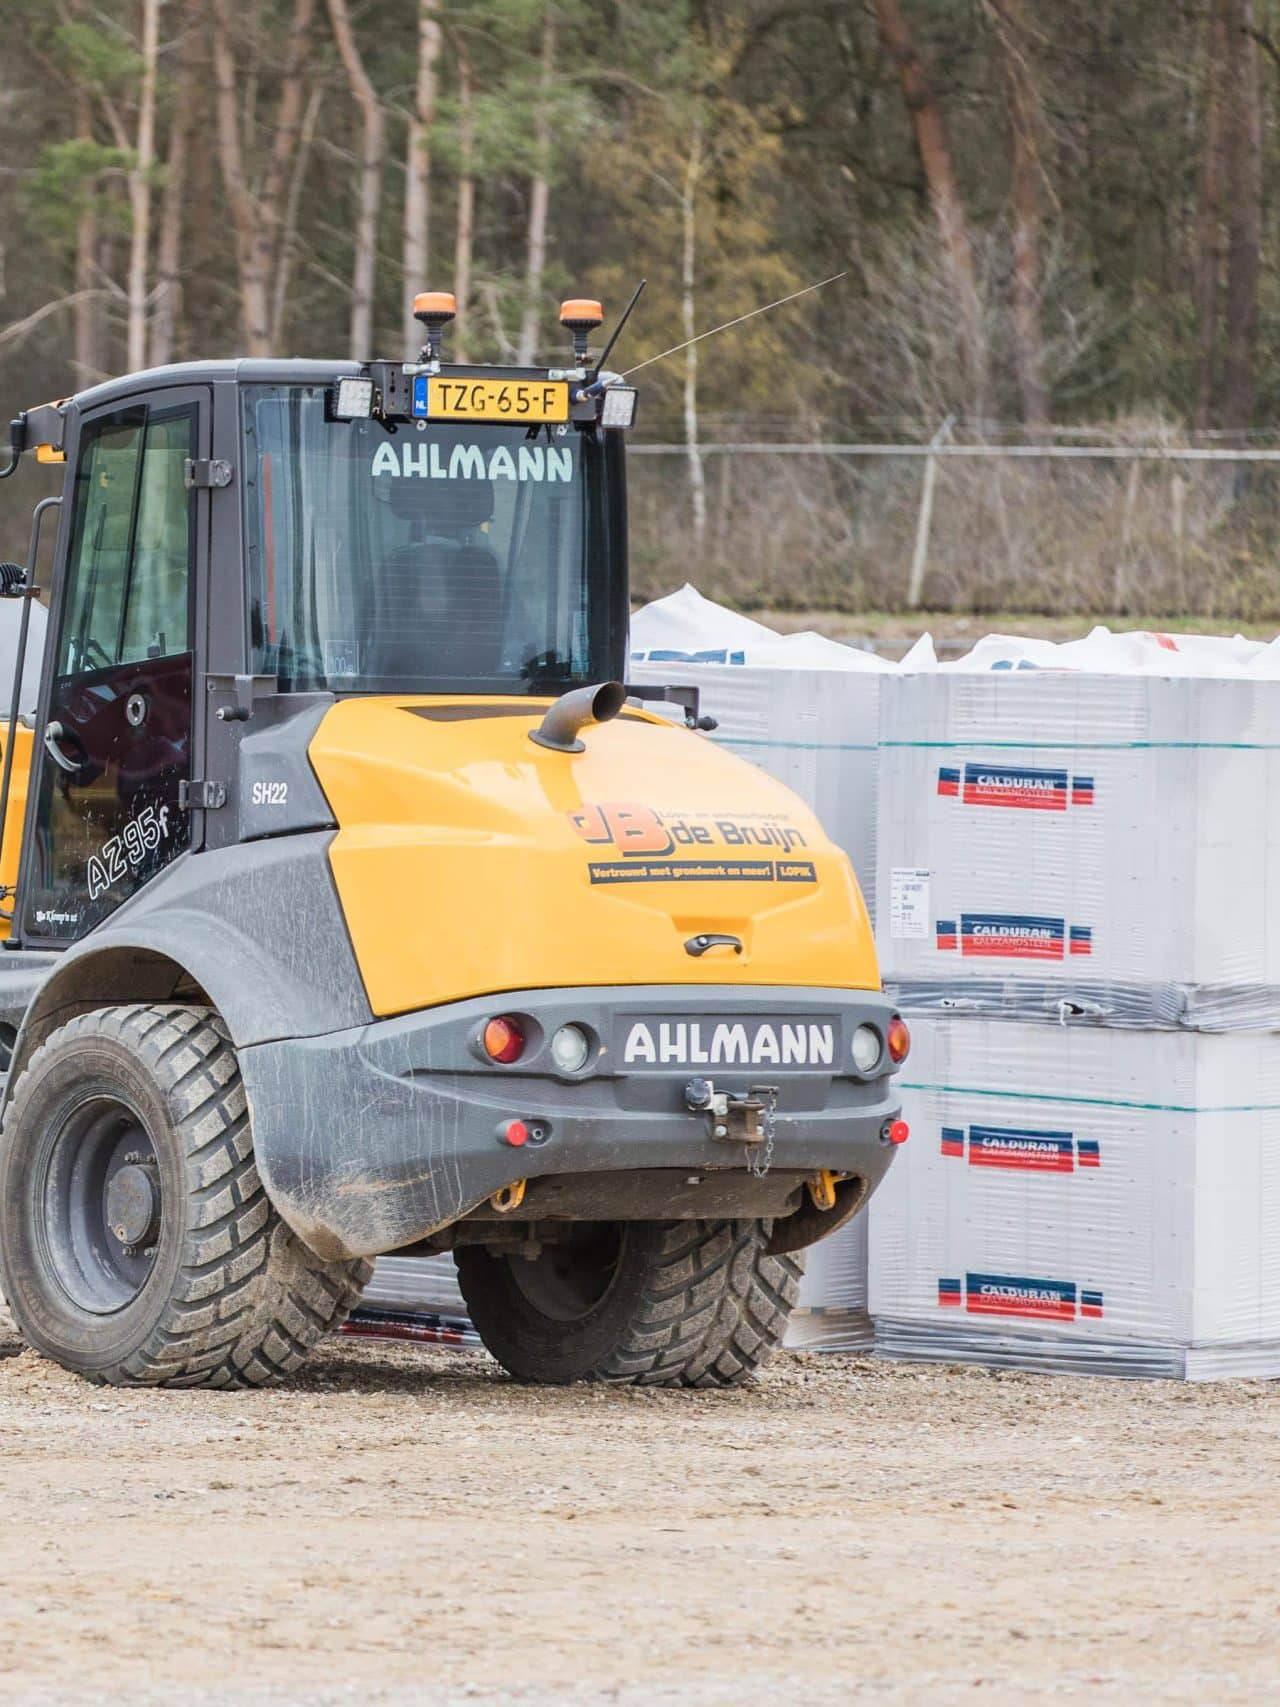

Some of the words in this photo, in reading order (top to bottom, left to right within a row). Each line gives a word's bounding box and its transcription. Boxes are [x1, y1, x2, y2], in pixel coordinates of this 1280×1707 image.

[415, 400, 427, 410] NL
[438, 384, 556, 414] TZG-65-F
[371, 441, 573, 482] AHLMANN
[252, 782, 288, 805] SH22
[977, 775, 1055, 790] CALDURAN
[671, 820, 714, 845] de
[716, 821, 807, 853] Bruijn
[87, 806, 169, 900] AZ95f
[972, 925, 1051, 938] CALDURAN
[624, 1023, 834, 1064] AHLMANN
[982, 1137, 1060, 1153] CALDURAN
[980, 1284, 1062, 1301] CALDURAN
